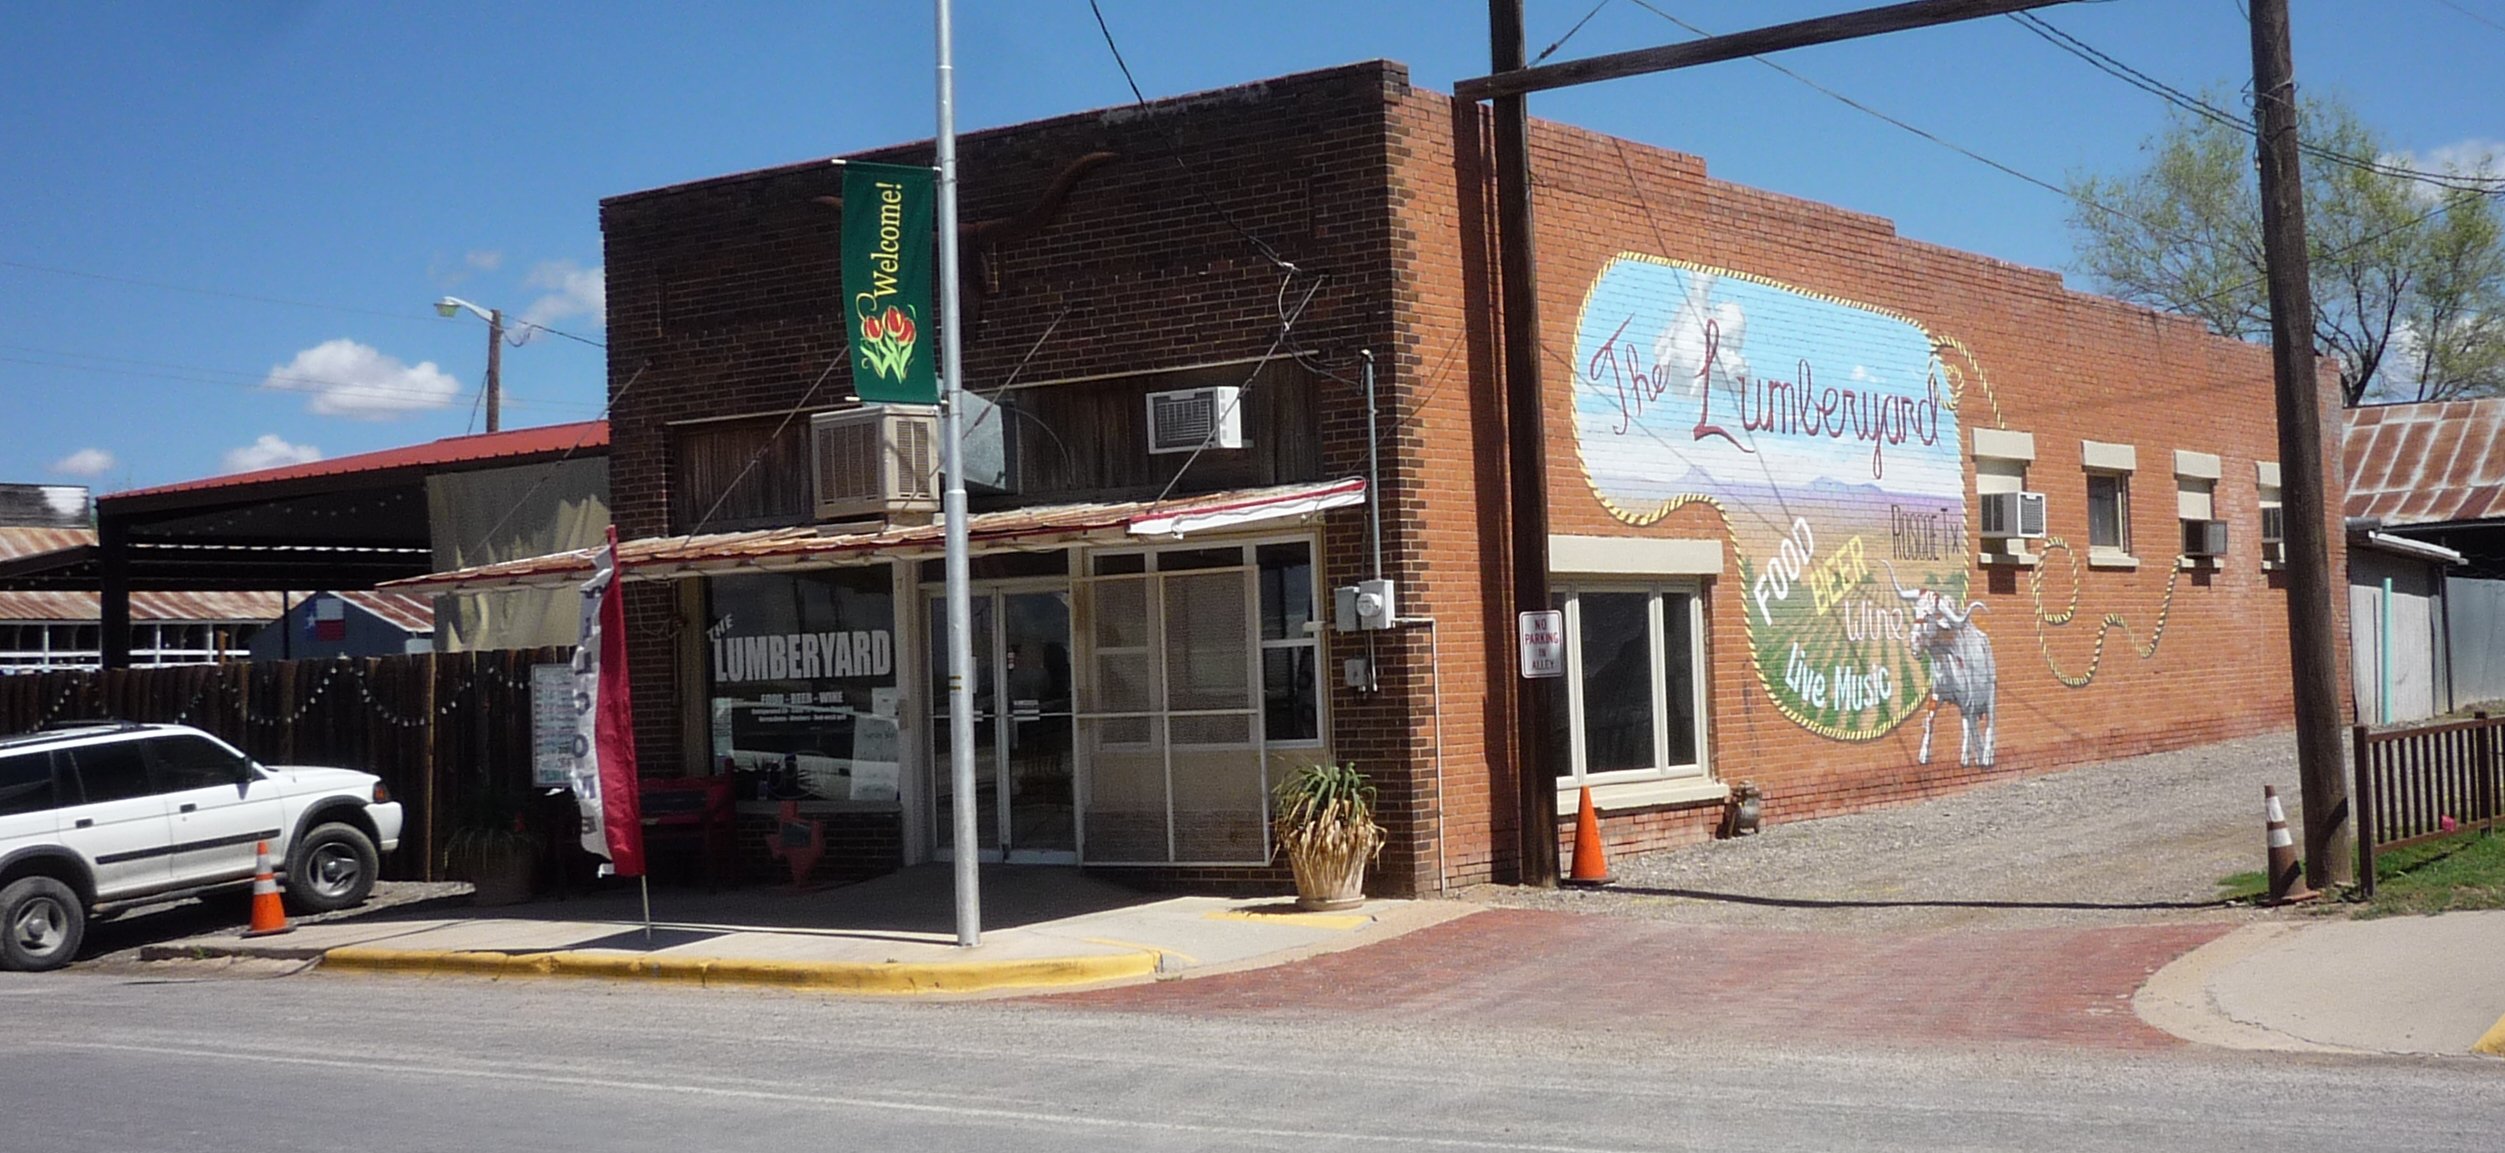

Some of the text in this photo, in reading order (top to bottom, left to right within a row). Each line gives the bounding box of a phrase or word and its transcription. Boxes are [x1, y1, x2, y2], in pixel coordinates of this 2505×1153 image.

[870, 181, 903, 298] Welcome!
[1589, 312, 1939, 480] The Lumberyard
[1753, 516, 1815, 626] FOOD
[1809, 535, 1868, 616] BEER
[706, 613, 734, 642] THE
[1524, 632, 1559, 645] PARKING
[1534, 618, 1547, 631] NO
[1845, 600, 1906, 641] Wine
[714, 630, 892, 682] LUMBERYARD
[1531, 659, 1554, 670] ALLEY
[1538, 648, 1546, 657] IN
[1785, 641, 1892, 711] Live Music
